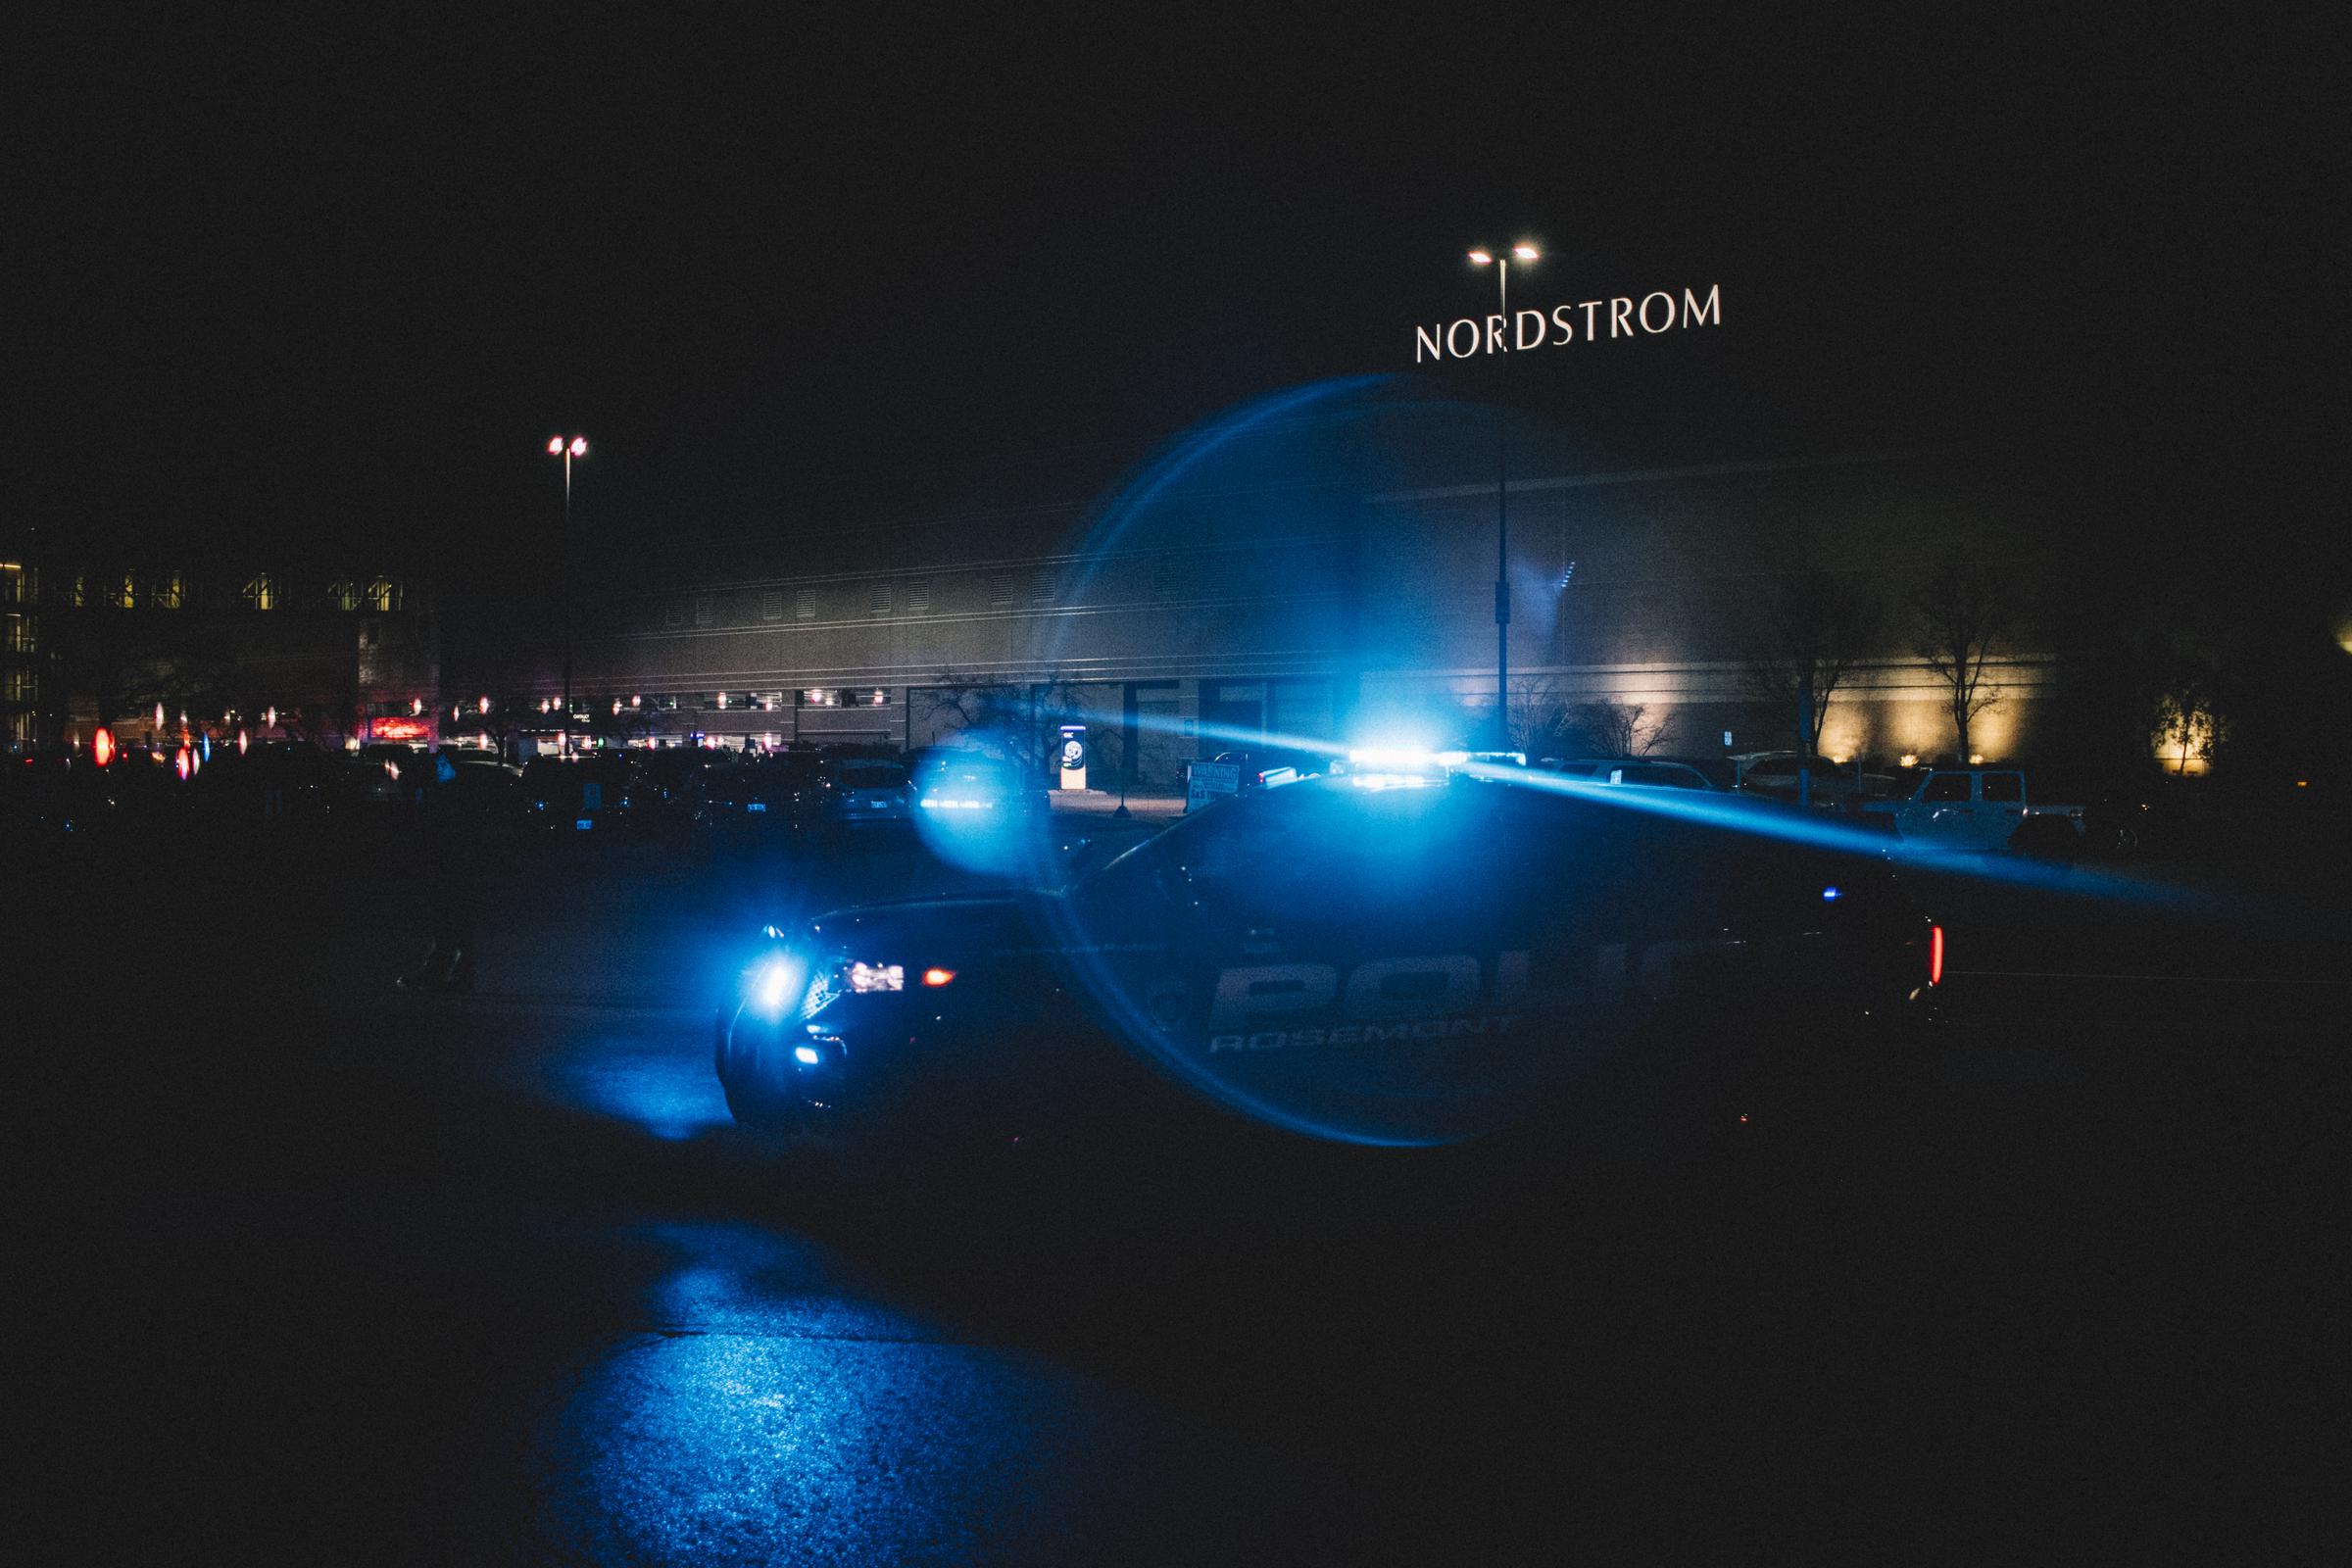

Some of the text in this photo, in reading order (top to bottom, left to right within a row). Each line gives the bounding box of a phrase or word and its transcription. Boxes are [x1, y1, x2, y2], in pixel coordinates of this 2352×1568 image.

[1416, 283, 1722, 364] NORDSTROM
[1193, 764, 1238, 780] WARNING
[1208, 938, 1749, 1029] POLIC
[1208, 1012, 1525, 1054] ROSEMONT
